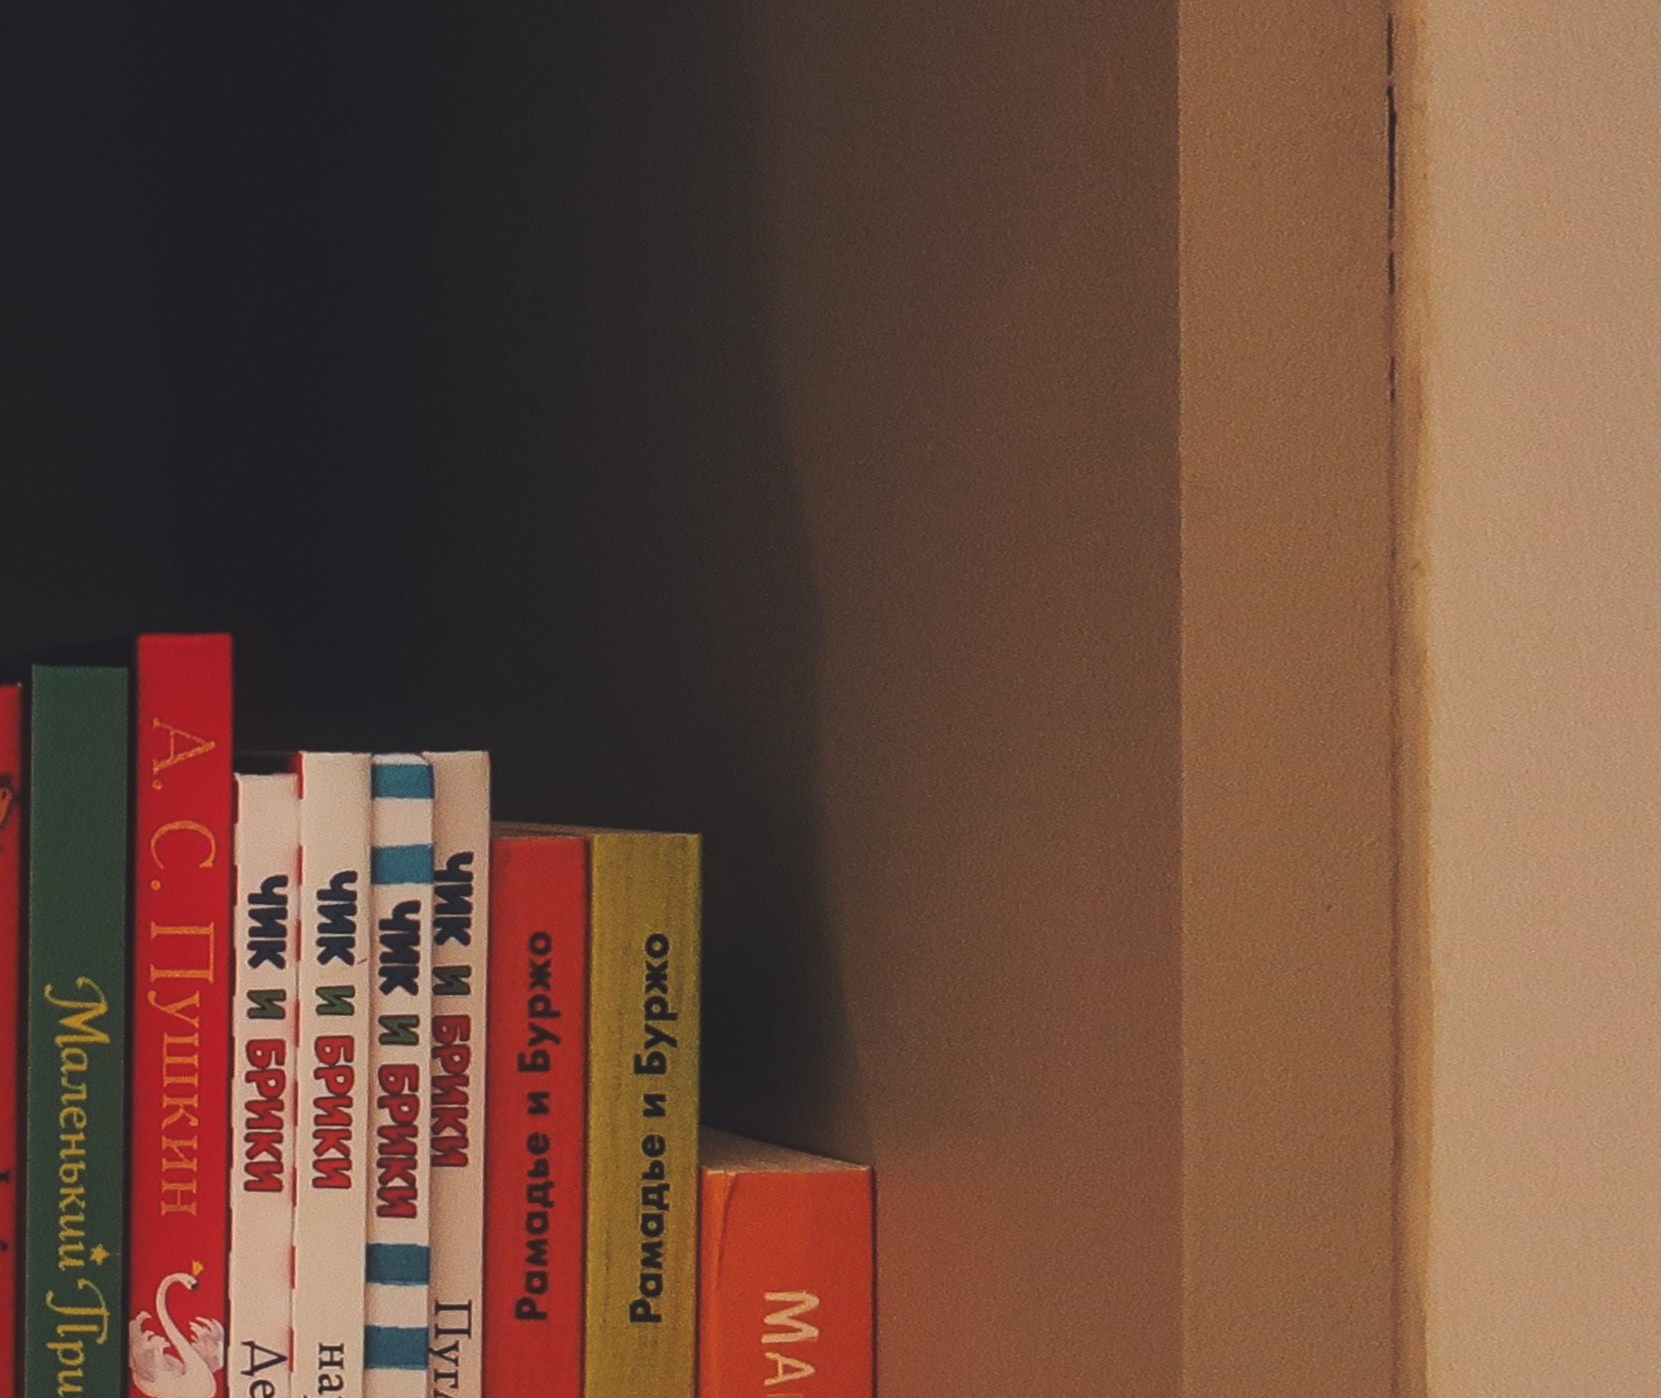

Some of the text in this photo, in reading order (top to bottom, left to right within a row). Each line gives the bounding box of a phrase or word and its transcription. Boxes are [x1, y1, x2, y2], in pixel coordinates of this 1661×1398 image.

[44, 977, 110, 1270] Маленький
[148, 716, 216, 1215] А. С. Пушкин
[246, 876, 287, 1190] ЧИК И БРИКИ
[313, 872, 357, 1188] ЧИК И БРИКИ
[630, 934, 678, 1323] Рамадье и Буржо
